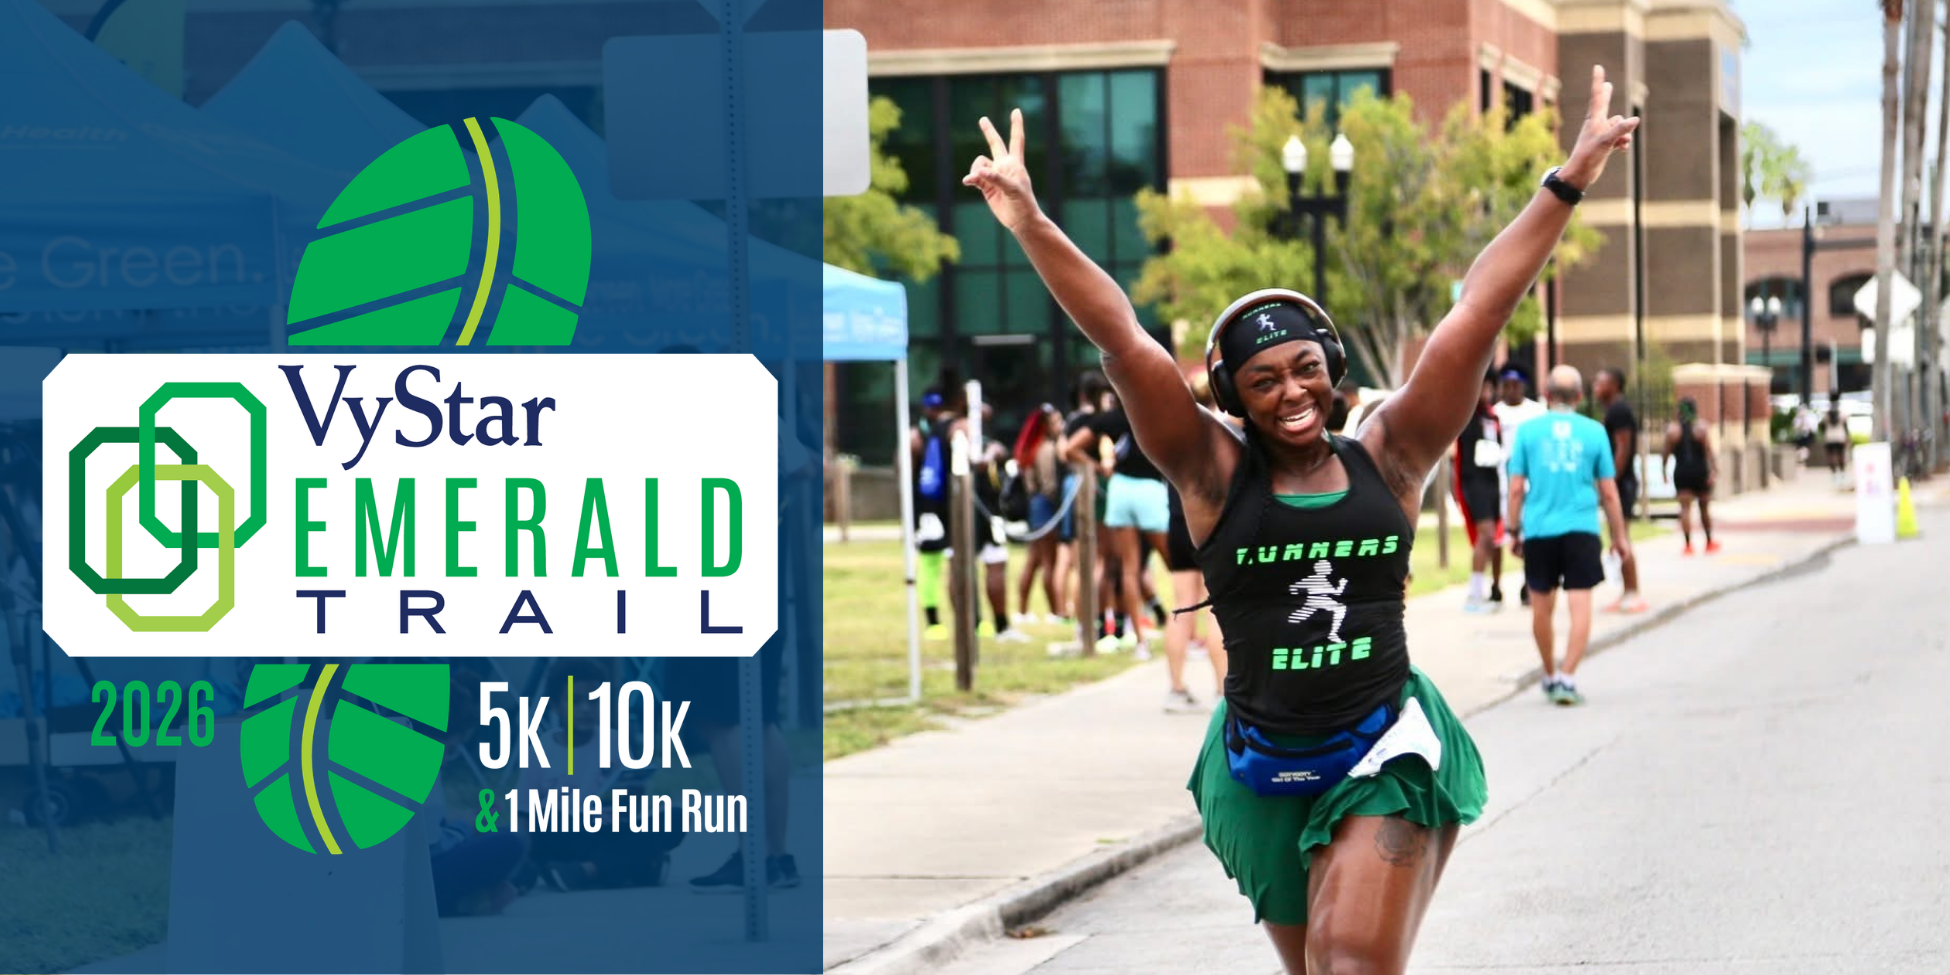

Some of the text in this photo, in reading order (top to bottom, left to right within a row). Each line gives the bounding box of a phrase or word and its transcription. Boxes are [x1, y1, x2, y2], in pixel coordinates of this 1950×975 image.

[41, 235, 264, 290] Green.
[1256, 329, 1288, 345] ELITE
[1272, 637, 1372, 670] ELITE
